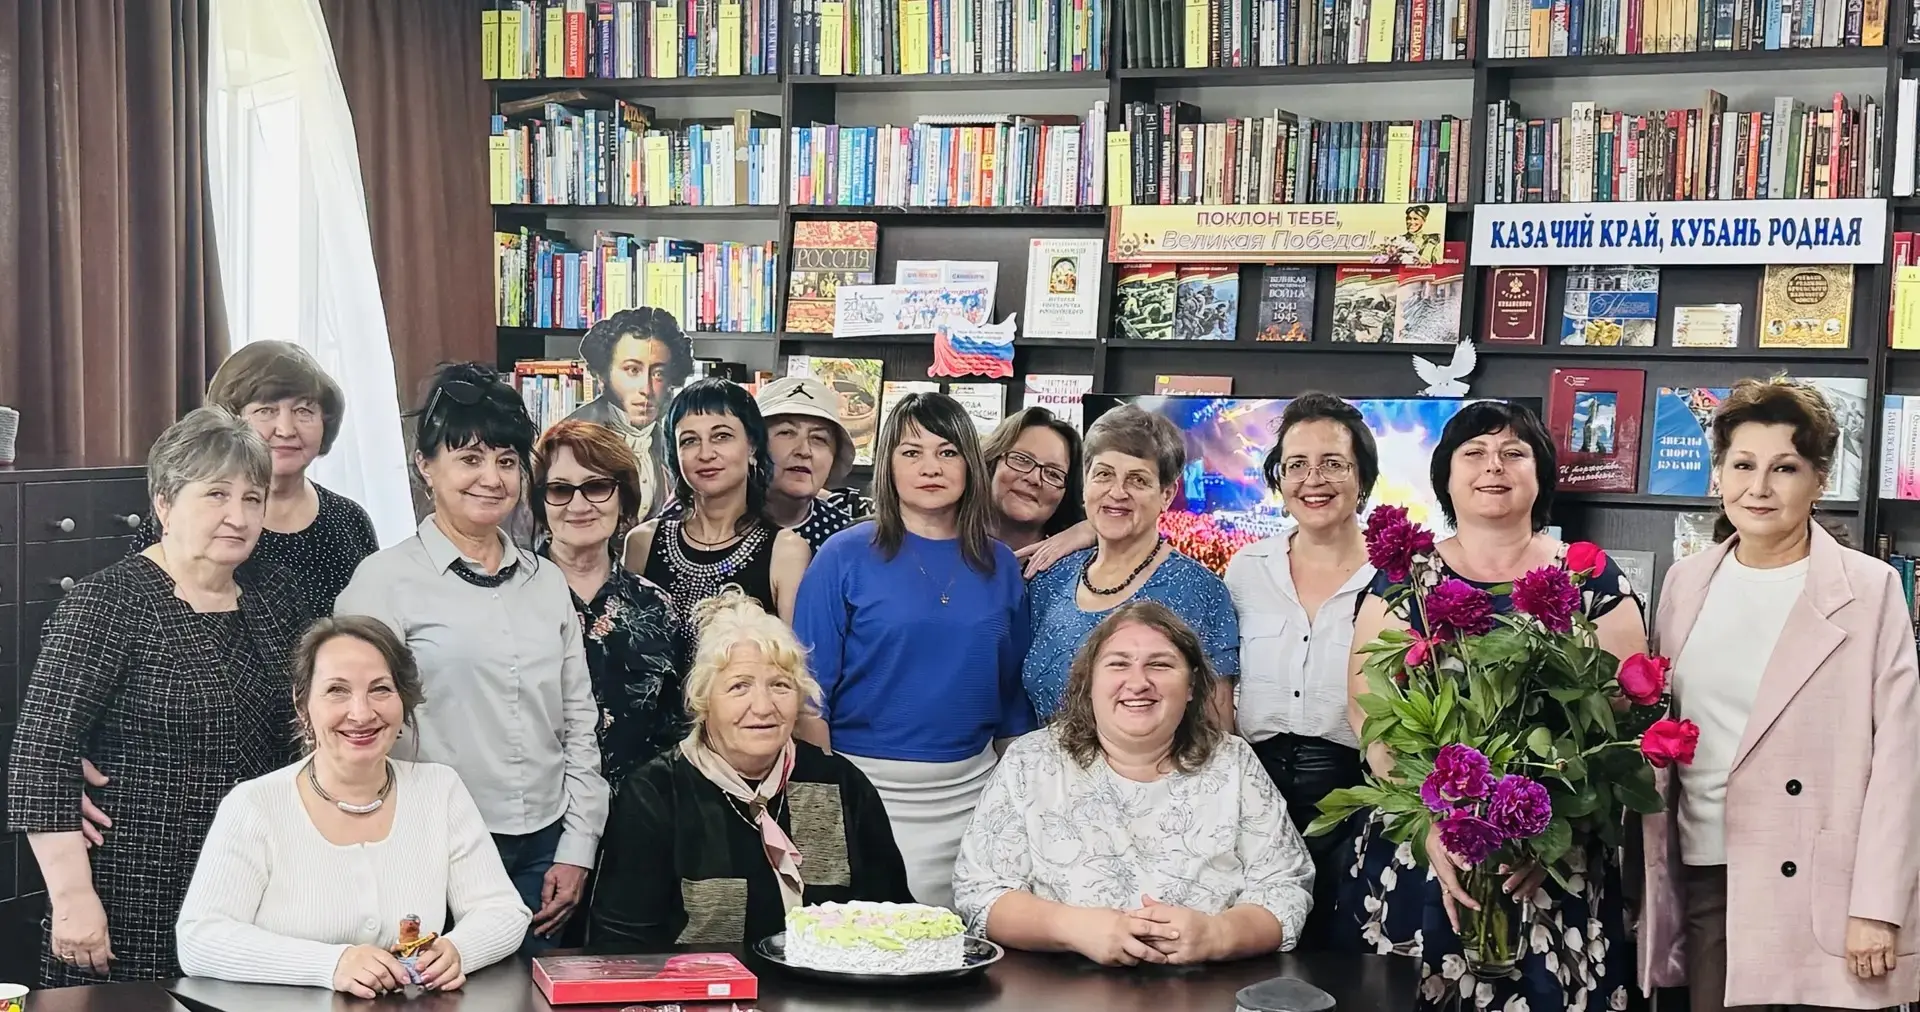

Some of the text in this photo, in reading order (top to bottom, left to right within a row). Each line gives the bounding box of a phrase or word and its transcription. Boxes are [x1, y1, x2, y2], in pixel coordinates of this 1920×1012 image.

[569, 14, 578, 69] МАТЕМАТИКА
[1411, 19, 1423, 60] ГЕВАРА
[597, 121, 607, 193] СТРАНЫ
[1196, 210, 1343, 229] ПОКЛОН ТЕБЕ,
[1161, 230, 1376, 250] Великая Победа!
[1490, 212, 1862, 253] КАЗАЧИЙ КРАЙ, КУБАНЬ РОДНАЯ
[796, 248, 870, 268] РОССИЯ
[1269, 275, 1307, 283] ВЕЛИКАЯ
[1268, 288, 1305, 298] ВОЙНА
[1274, 302, 1297, 312] 1941
[1273, 312, 1298, 324] 1945
[1037, 394, 1084, 404] РОССИИ
[1659, 448, 1701, 459] СПОРТА
[1658, 460, 1702, 471] КУБАНИ
